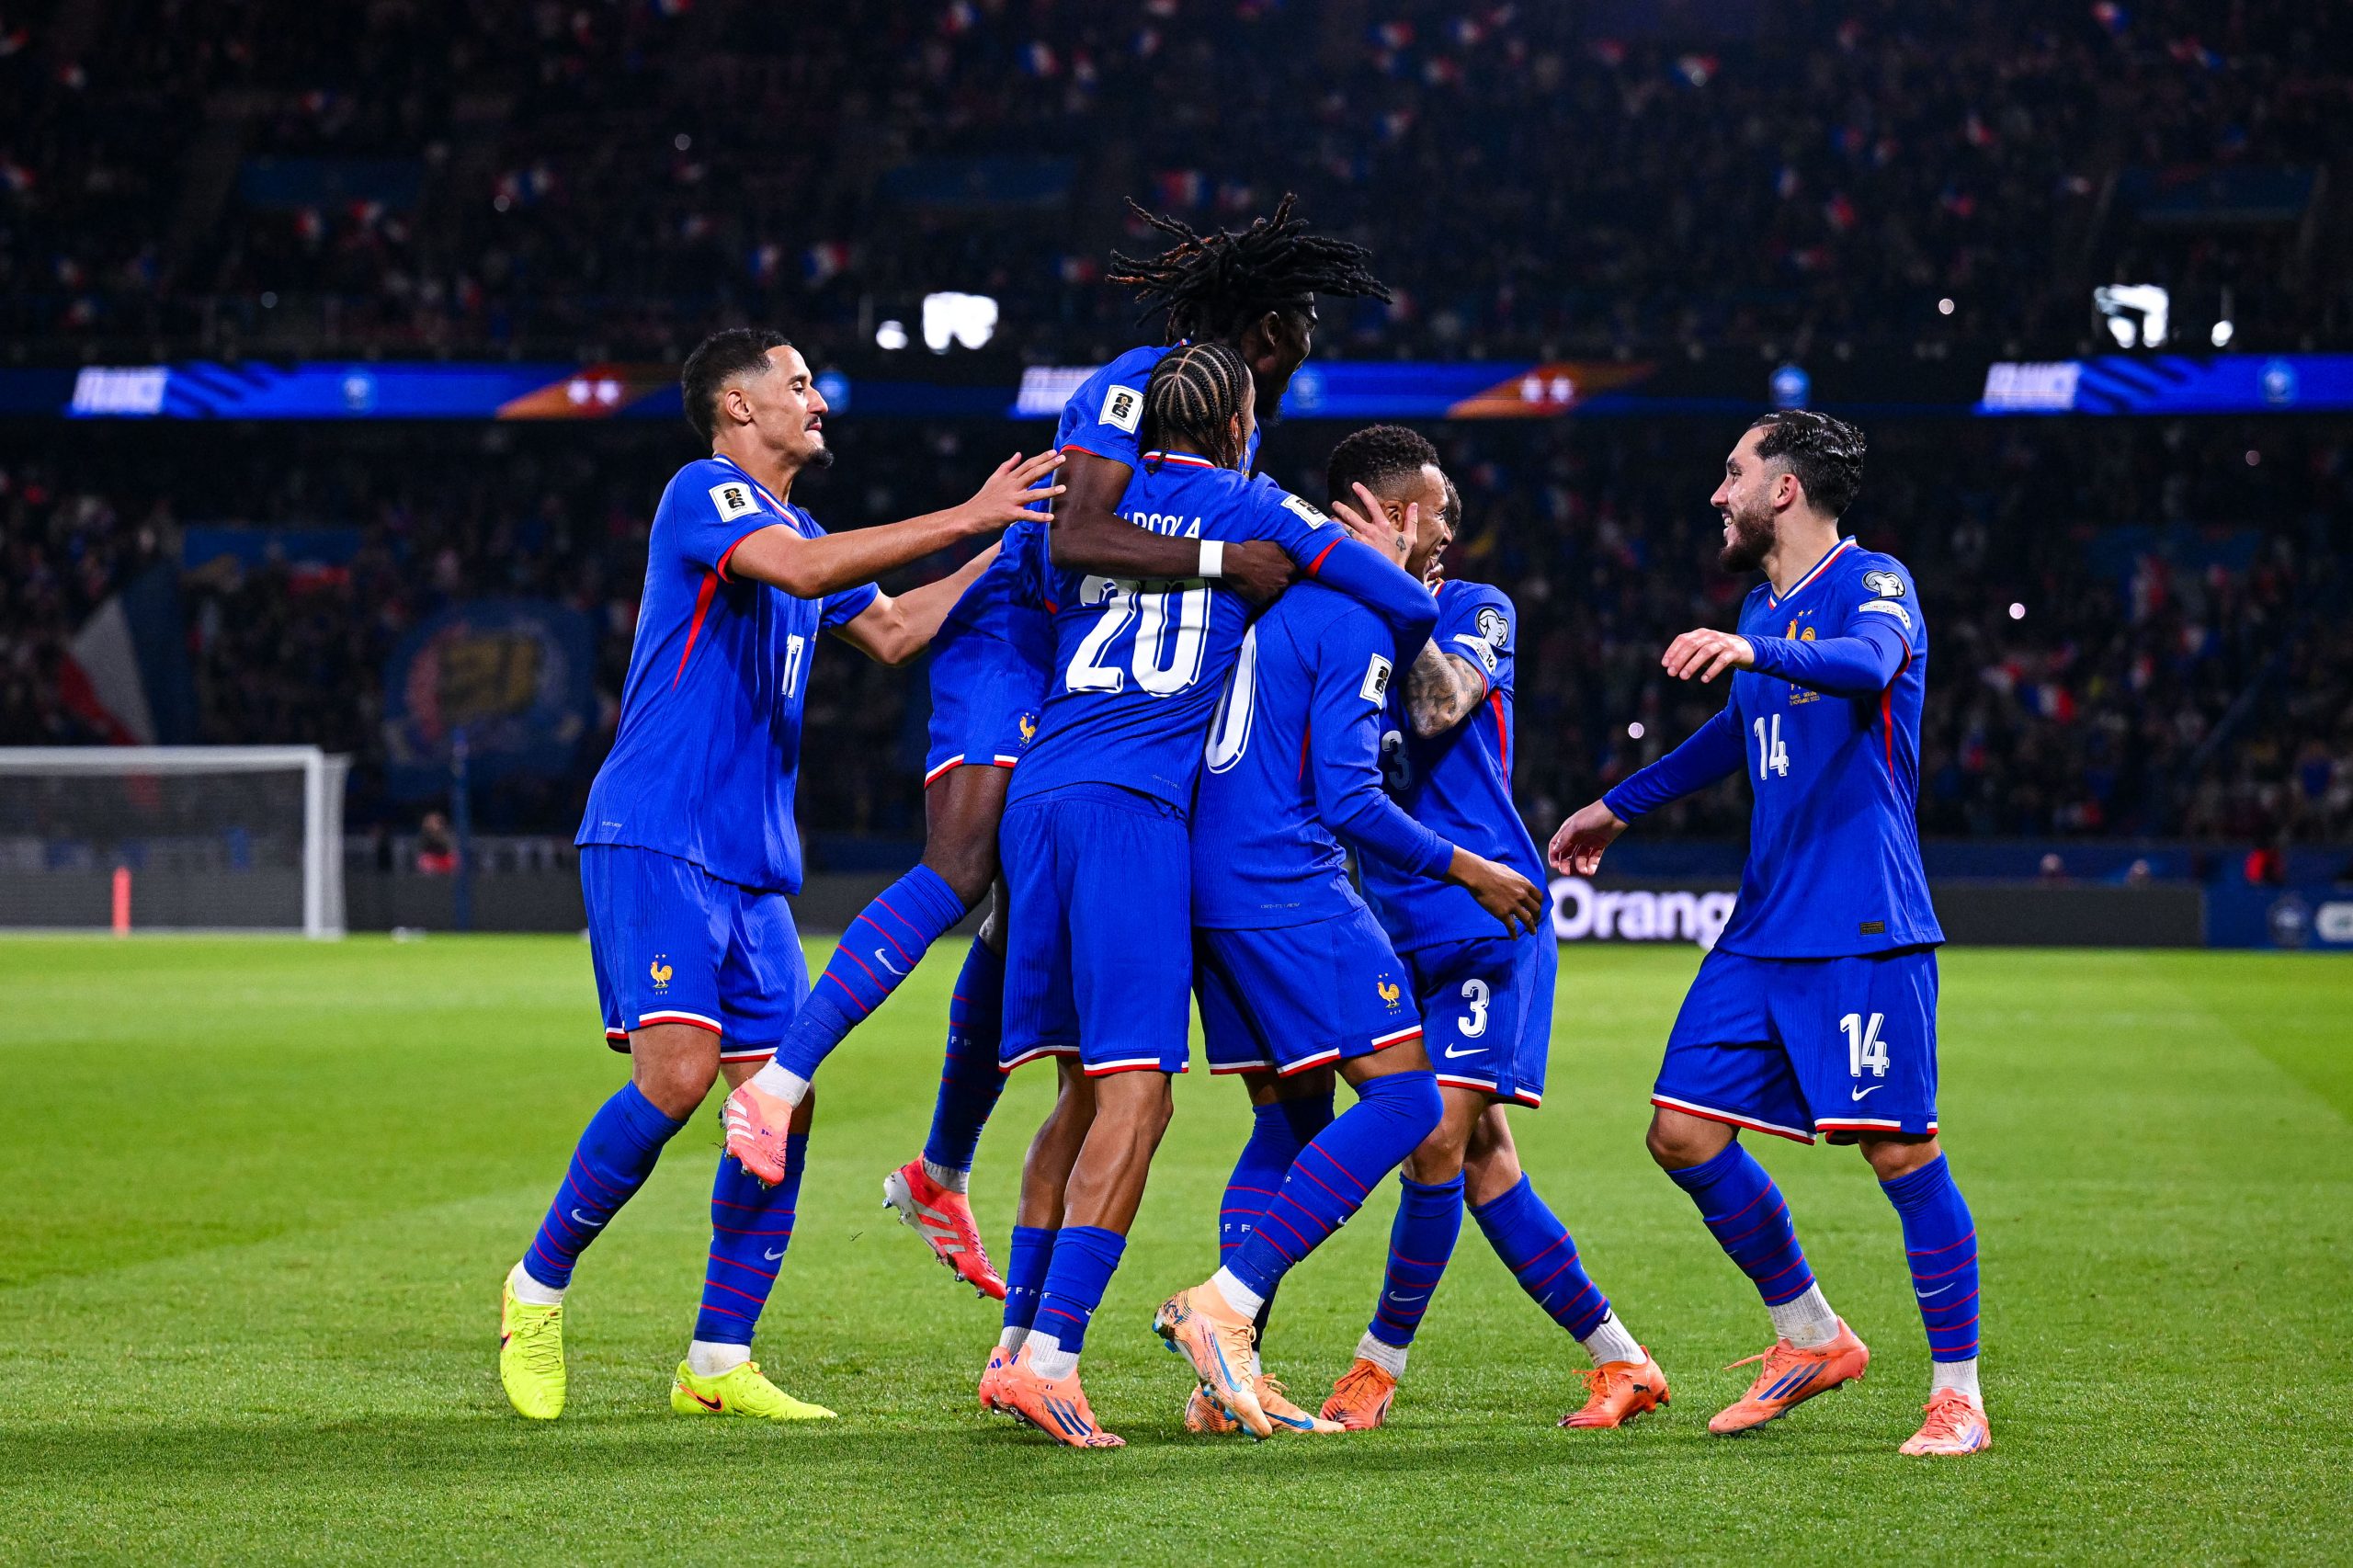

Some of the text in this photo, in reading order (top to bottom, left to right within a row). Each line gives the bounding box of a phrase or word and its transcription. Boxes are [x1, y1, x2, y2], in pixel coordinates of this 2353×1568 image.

[1065, 574, 1211, 698] 20
[1381, 730, 1413, 790] 3
[1753, 713, 1790, 780] 14
[1458, 978, 1489, 1038] 3
[1839, 1013, 1890, 1077] 14
